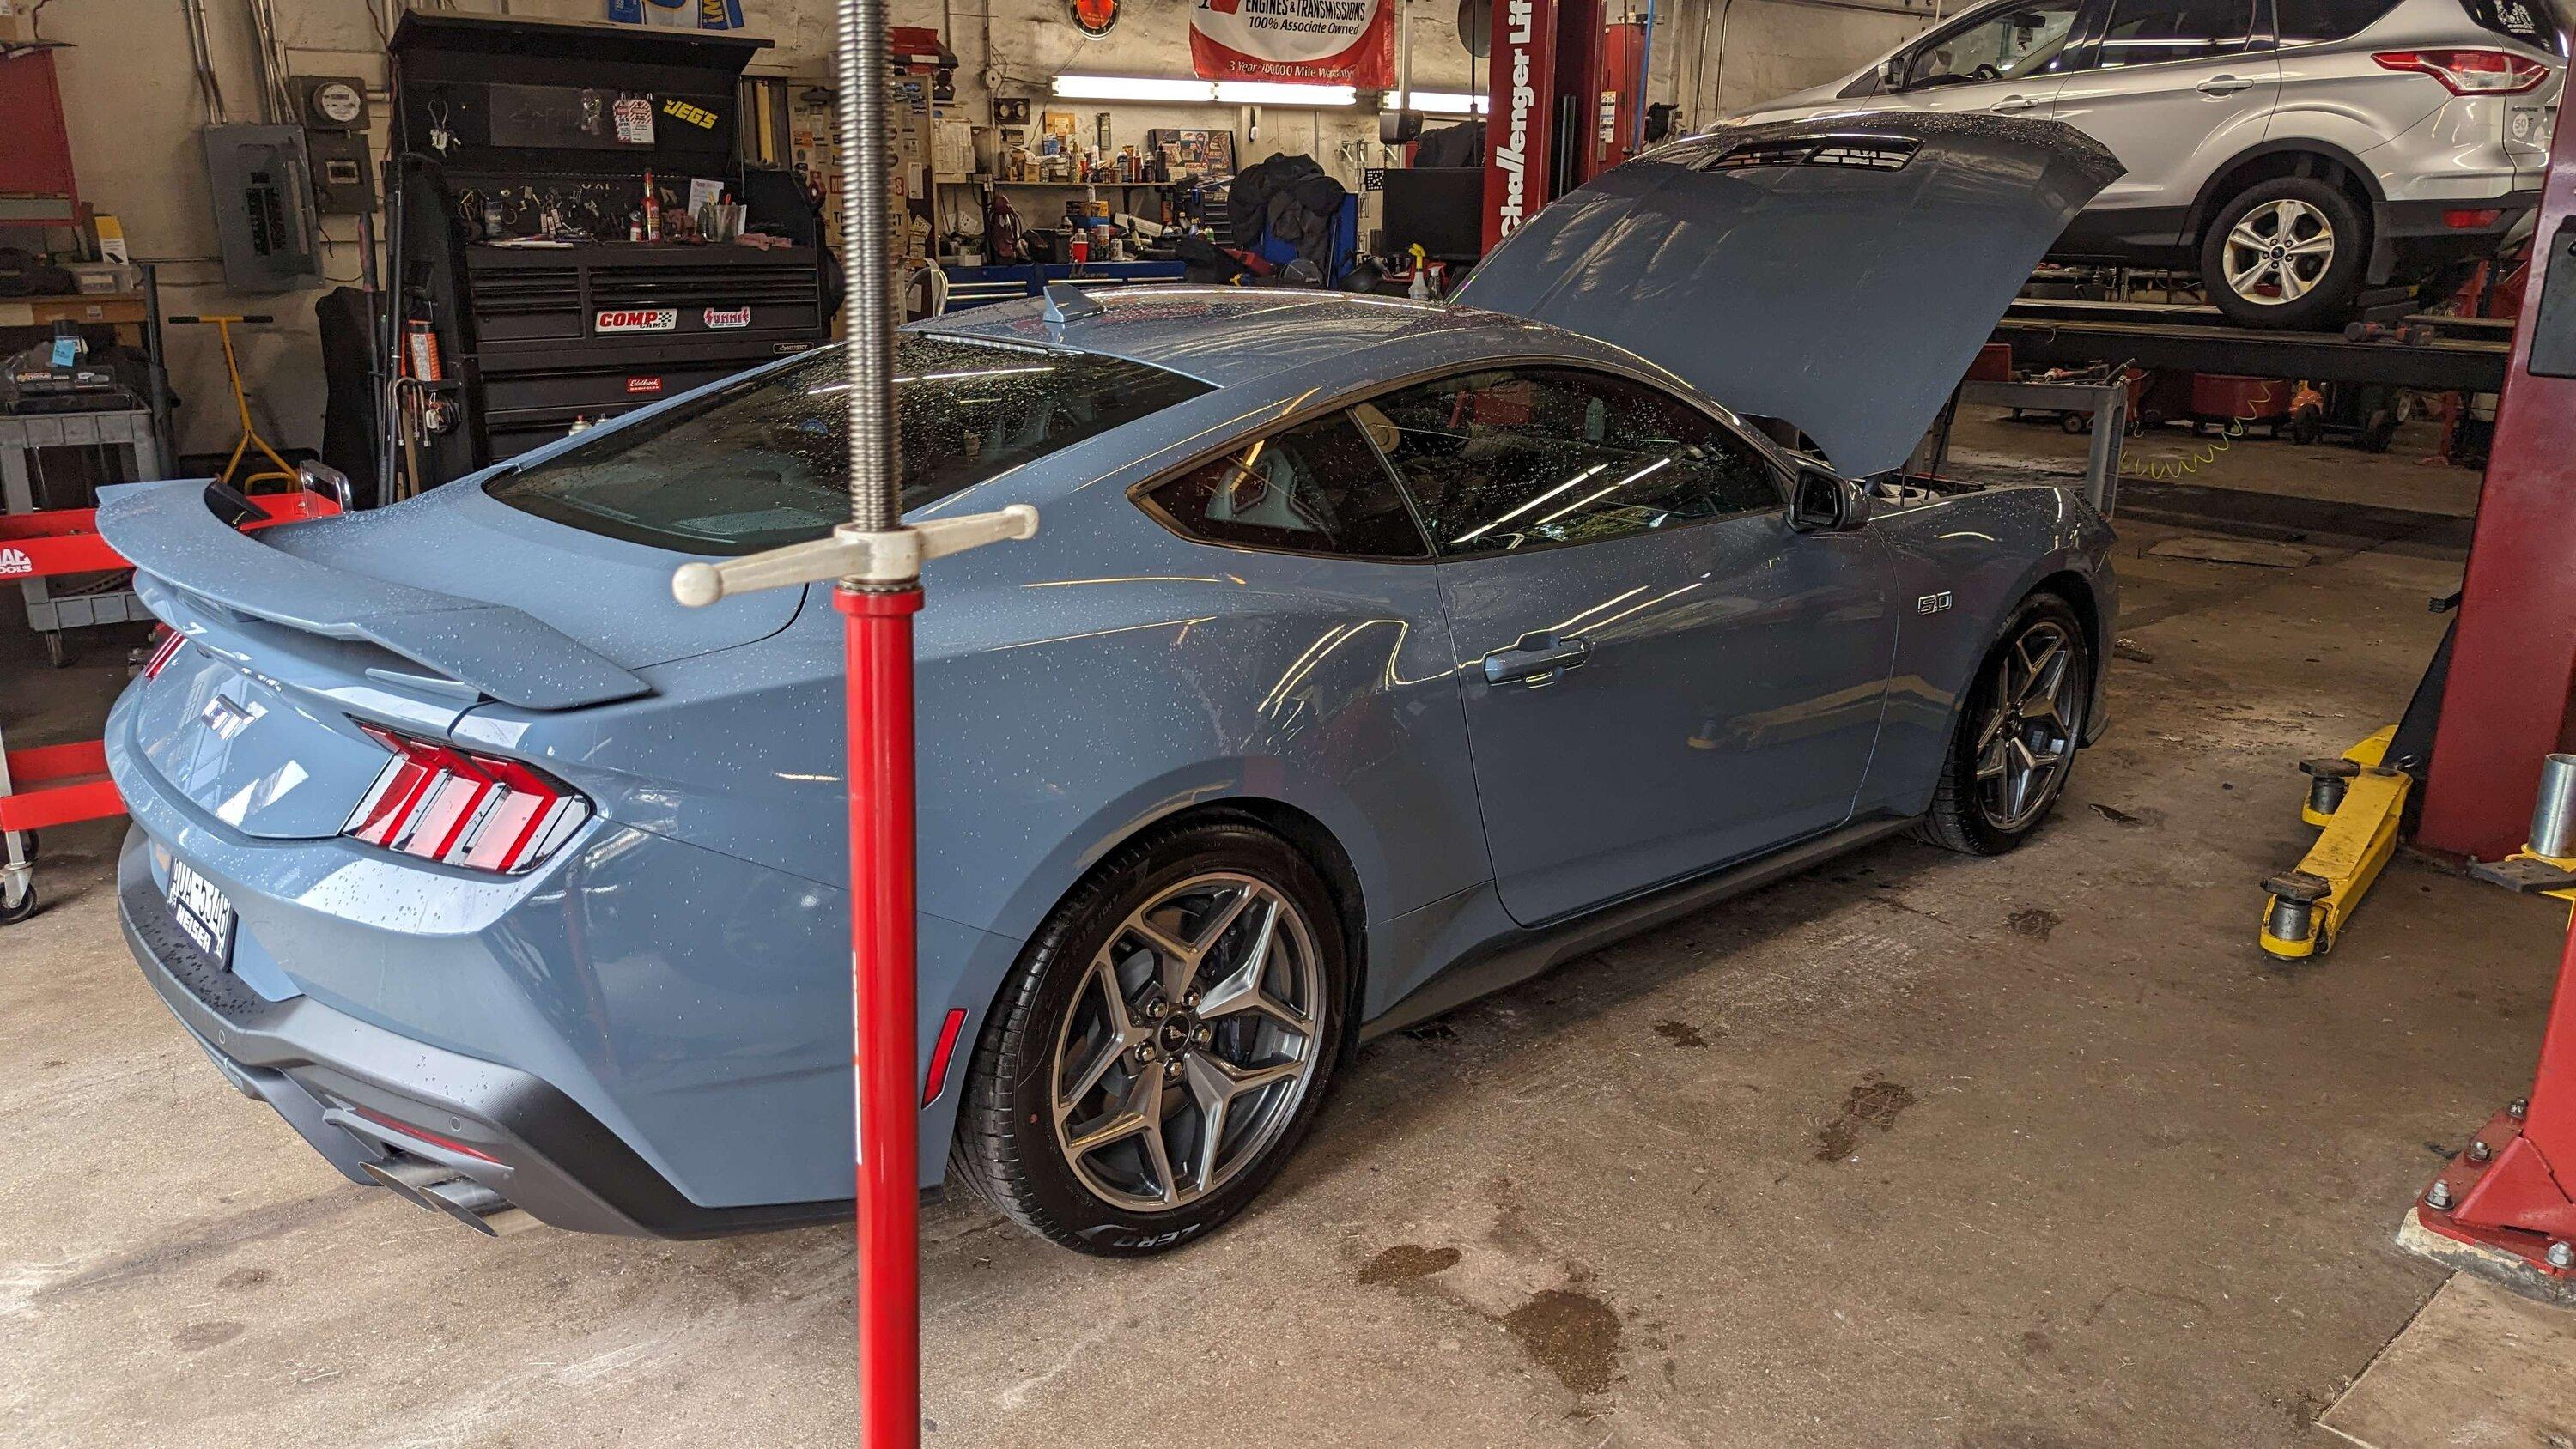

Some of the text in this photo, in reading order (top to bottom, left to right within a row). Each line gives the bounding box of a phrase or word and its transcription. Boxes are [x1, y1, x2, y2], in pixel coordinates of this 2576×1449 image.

[1245, 0, 1365, 21] ENGINES & TRANSMISSIONS
[1249, 15, 1359, 35] 100% Associate Owned
[1230, 60, 1236, 71] 3
[1295, 65, 1316, 77] Mile
[1496, 0, 1534, 238] Challenger Lif
[599, 312, 659, 327] COMP
[639, 321, 668, 330] CAMS
[0, 548, 32, 566] AC
[0, 564, 33, 574] OOLS
[175, 903, 212, 954] HEISER
